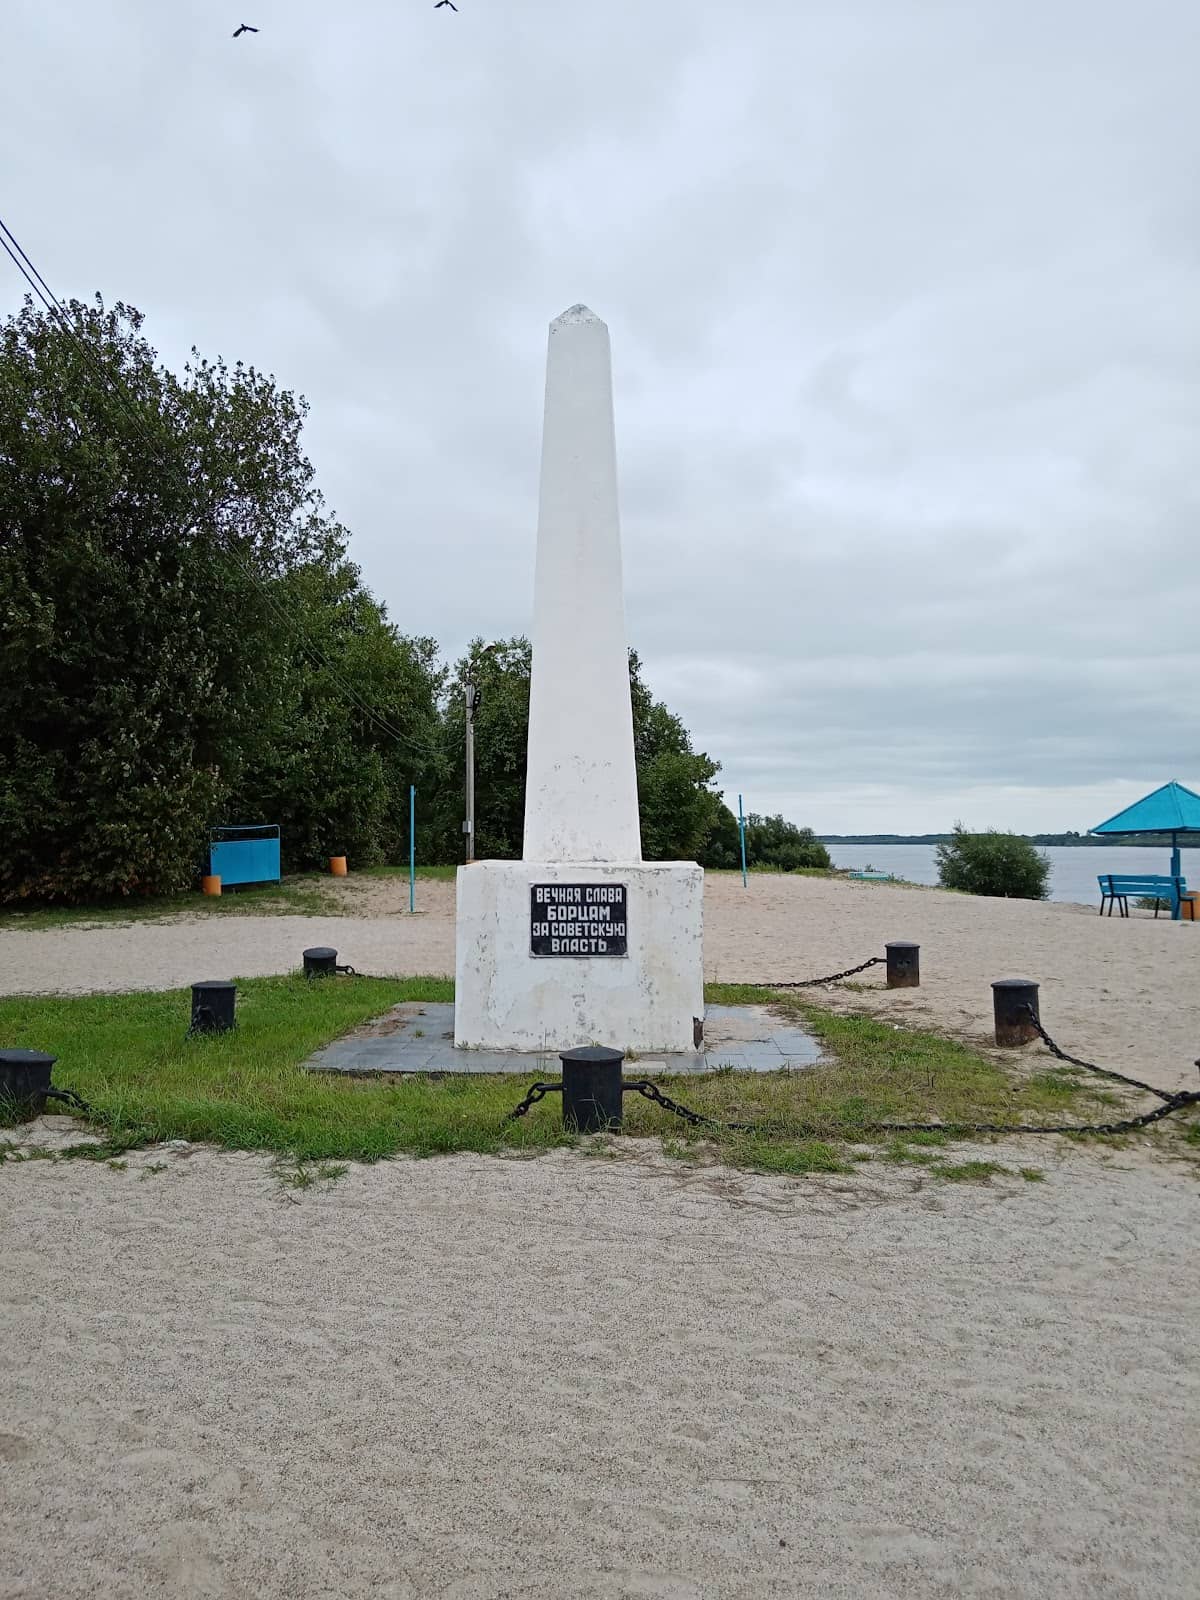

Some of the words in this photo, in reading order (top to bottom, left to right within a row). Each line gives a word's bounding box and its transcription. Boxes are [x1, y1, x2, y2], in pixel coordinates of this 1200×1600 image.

[536, 888, 581, 903] ВЕЧНАЯ
[585, 888, 623, 903] СЛАВА
[547, 905, 611, 921] БОРЦАМ
[532, 922, 549, 937] ЗА
[551, 922, 626, 937] СОВЕТСКУЮ
[551, 938, 607, 953] ВЛАСТЬ
